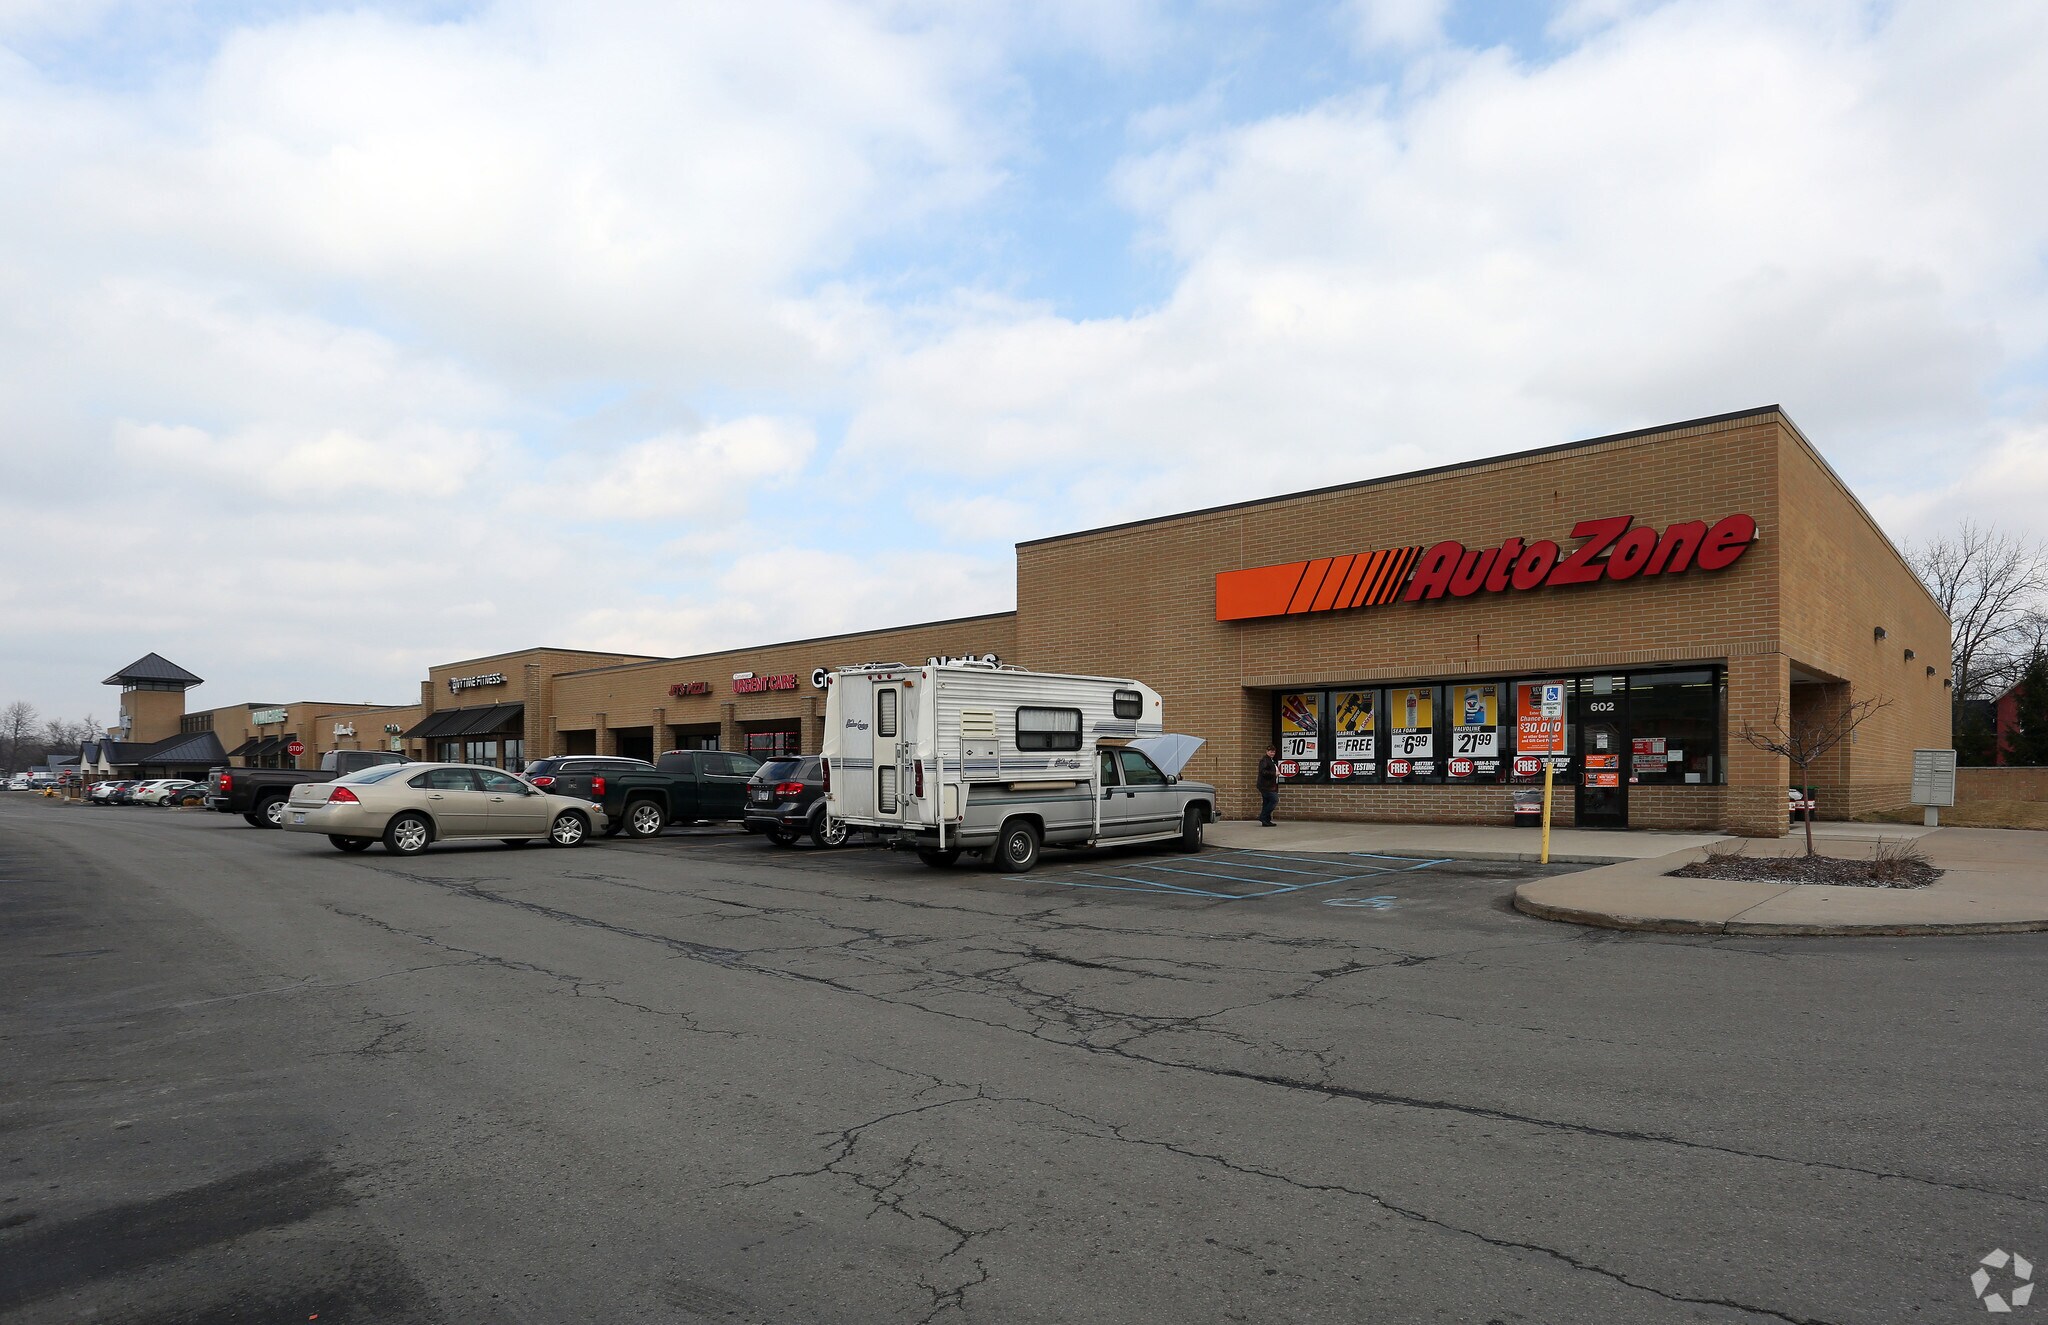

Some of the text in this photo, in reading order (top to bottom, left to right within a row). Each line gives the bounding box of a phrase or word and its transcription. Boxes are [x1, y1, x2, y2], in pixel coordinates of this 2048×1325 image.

[1403, 514, 1757, 602] AutoZone
[476, 673, 500, 686] FITNESS
[732, 674, 795, 693] URGENT CARE
[1590, 702, 1615, 712] 602
[1289, 738, 1306, 756] $10
[1345, 738, 1373, 752] FREE
[1280, 763, 1297, 774] FREE
[1333, 764, 1351, 775] FREE
[1353, 762, 1376, 771] TESTING
[1390, 762, 1408, 774] FREE
[1451, 761, 1471, 773] FREE
[1517, 760, 1538, 772] FREE
